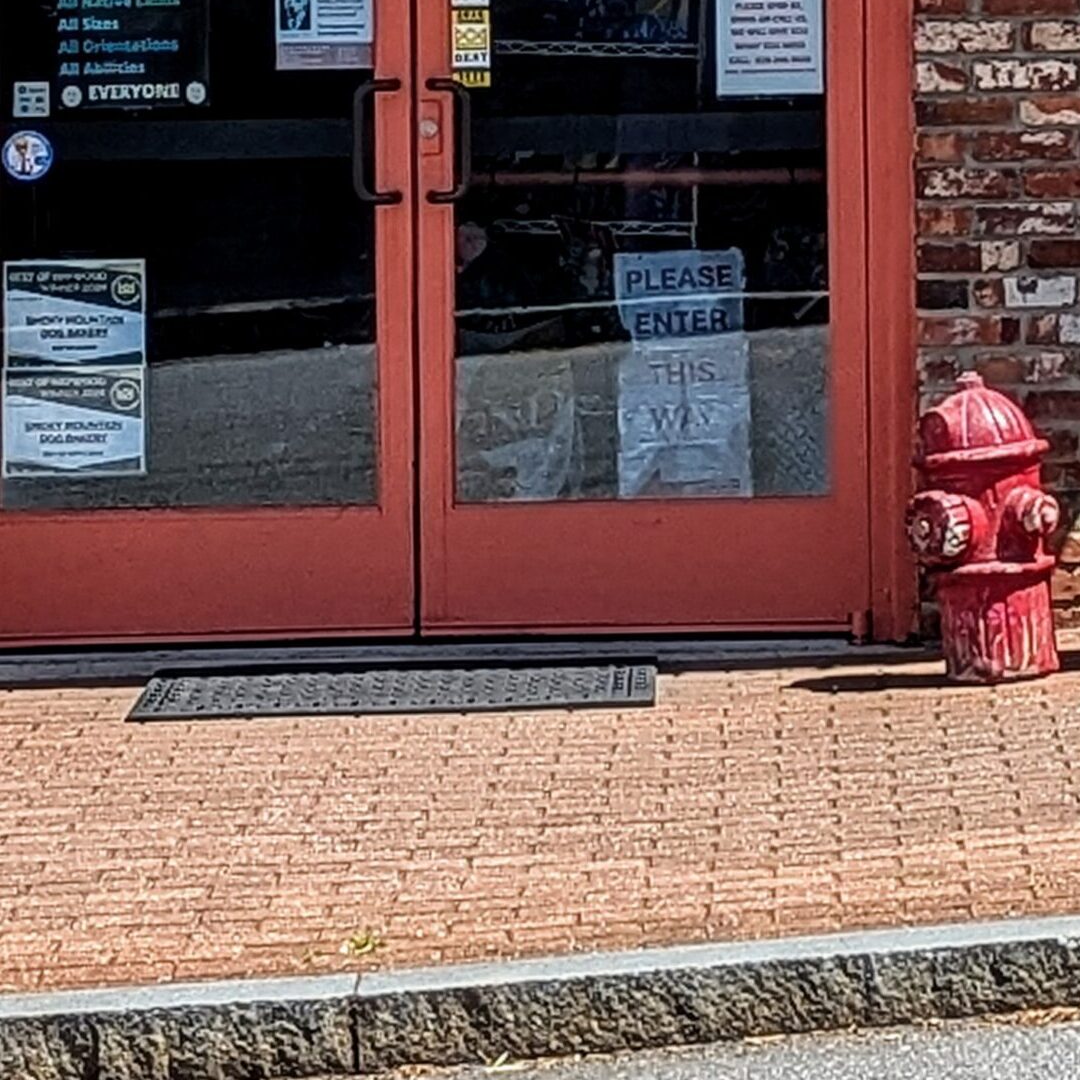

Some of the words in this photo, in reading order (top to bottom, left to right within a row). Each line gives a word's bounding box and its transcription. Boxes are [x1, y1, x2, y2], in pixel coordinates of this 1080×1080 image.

[58, 18, 78, 31] All
[58, 40, 79, 53] All
[59, 63, 79, 76] All
[88, 83, 180, 101] EVERYONE
[625, 264, 734, 293] PLEASE
[634, 308, 730, 336] ENTER
[650, 360, 716, 385] THIS
